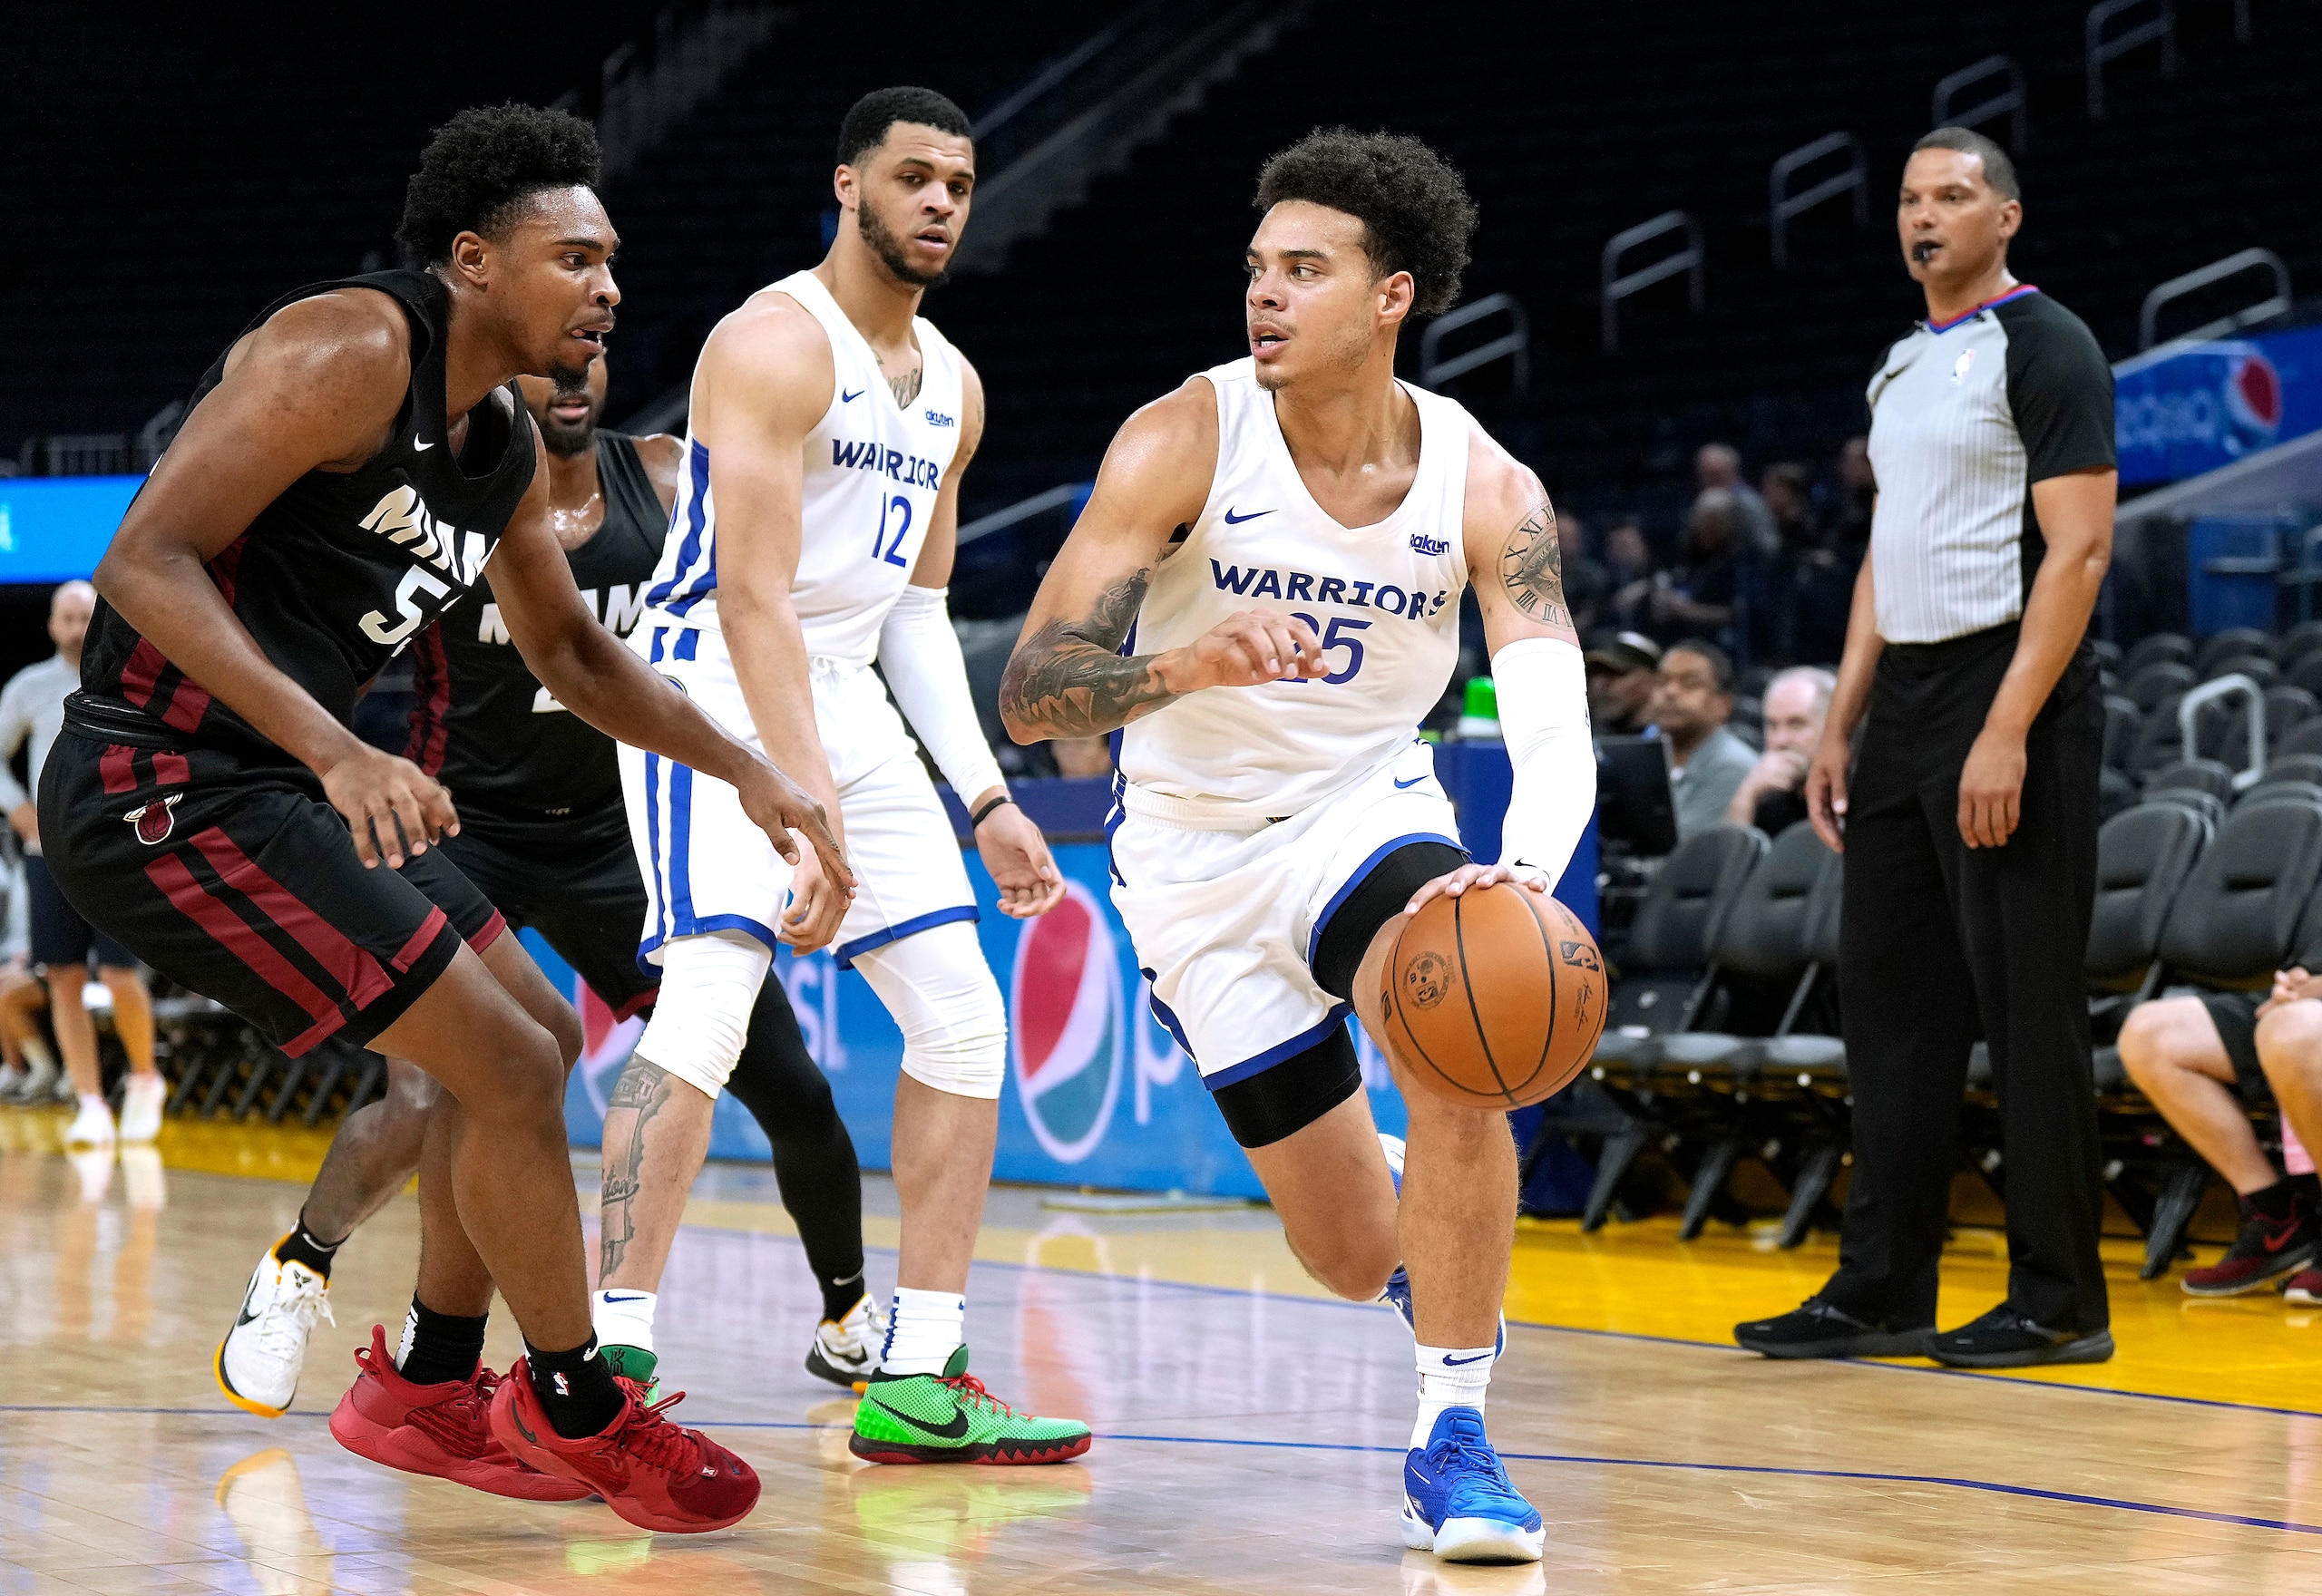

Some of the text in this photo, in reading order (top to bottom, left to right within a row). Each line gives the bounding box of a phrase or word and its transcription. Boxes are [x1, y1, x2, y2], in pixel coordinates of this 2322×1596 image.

[871, 491, 912, 569] 12
[357, 563, 464, 658] 5
[1209, 558, 1447, 620] WARRIORS
